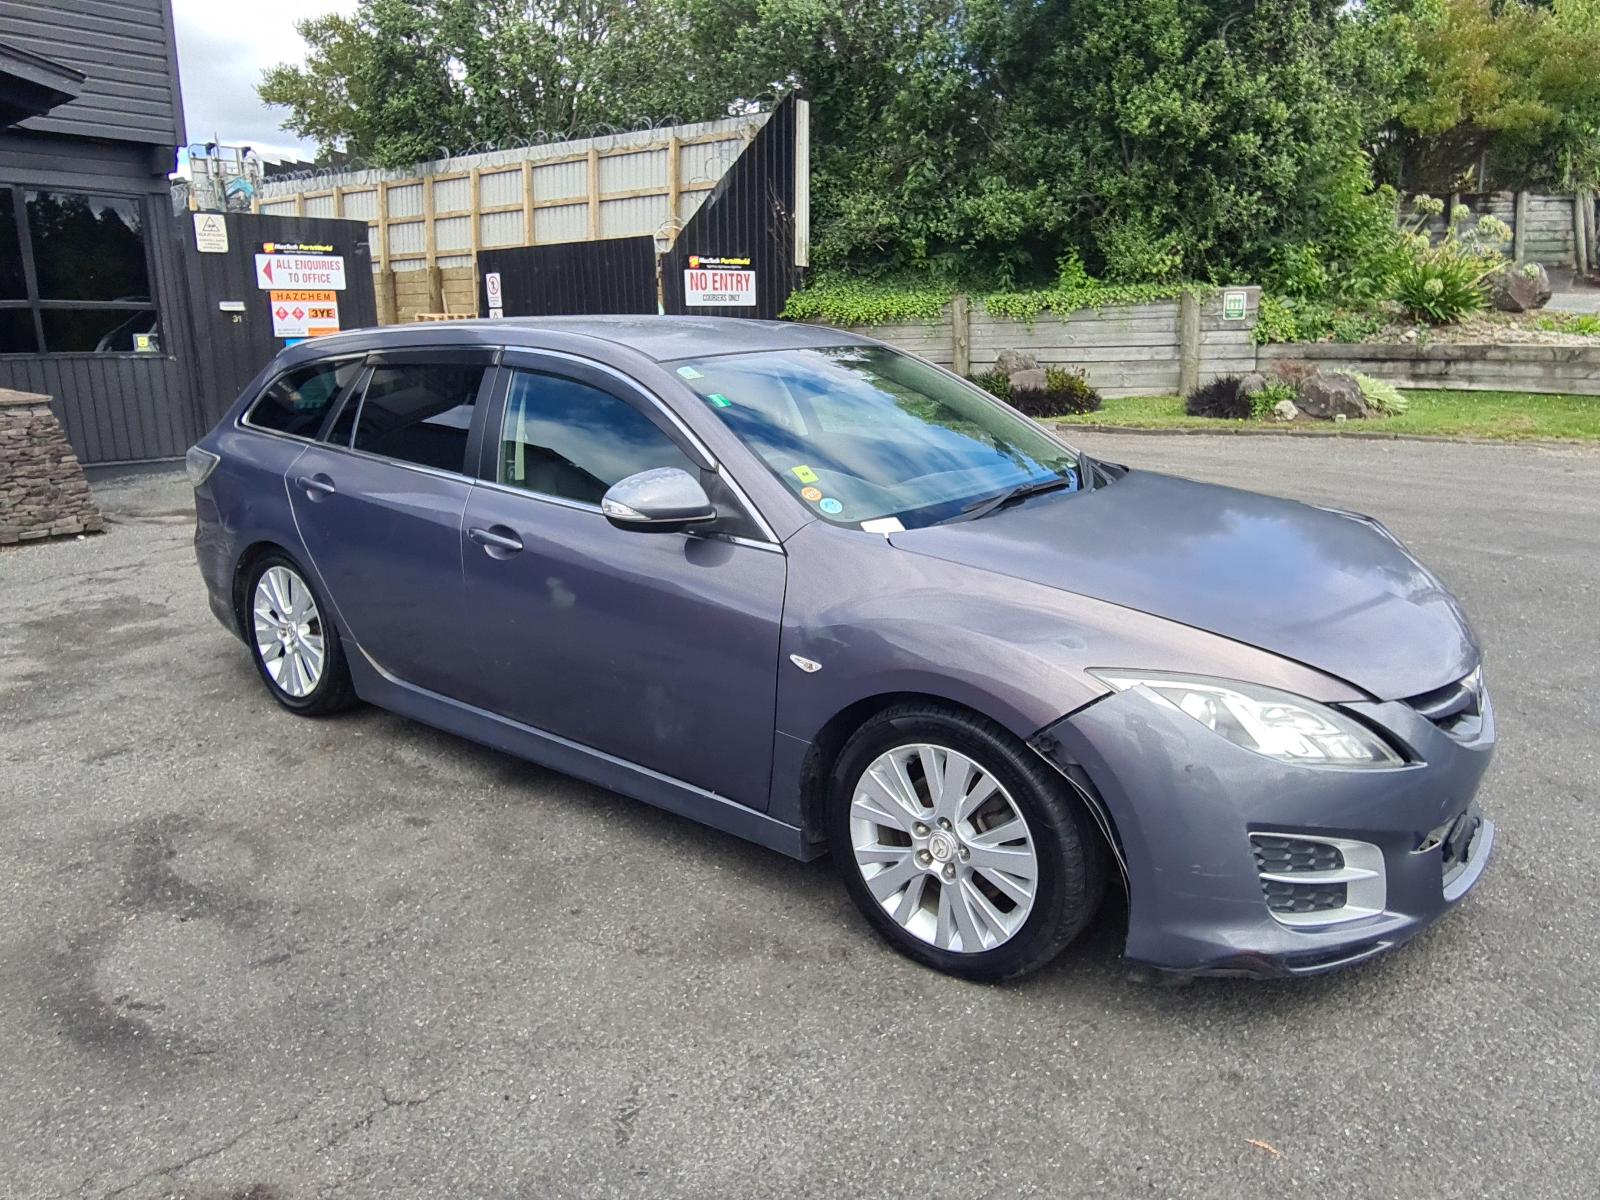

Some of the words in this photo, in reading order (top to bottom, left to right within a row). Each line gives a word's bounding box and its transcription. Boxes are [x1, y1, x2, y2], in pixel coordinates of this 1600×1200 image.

[276, 259, 292, 269] ALL
[295, 260, 340, 270] ENQUIRIES
[288, 273, 299, 283] TO
[302, 273, 331, 284] OFFICE
[690, 272, 707, 290] NO
[712, 272, 750, 291] ENTRY
[276, 292, 330, 300] HAZCHEM
[312, 309, 333, 318] 3YE
